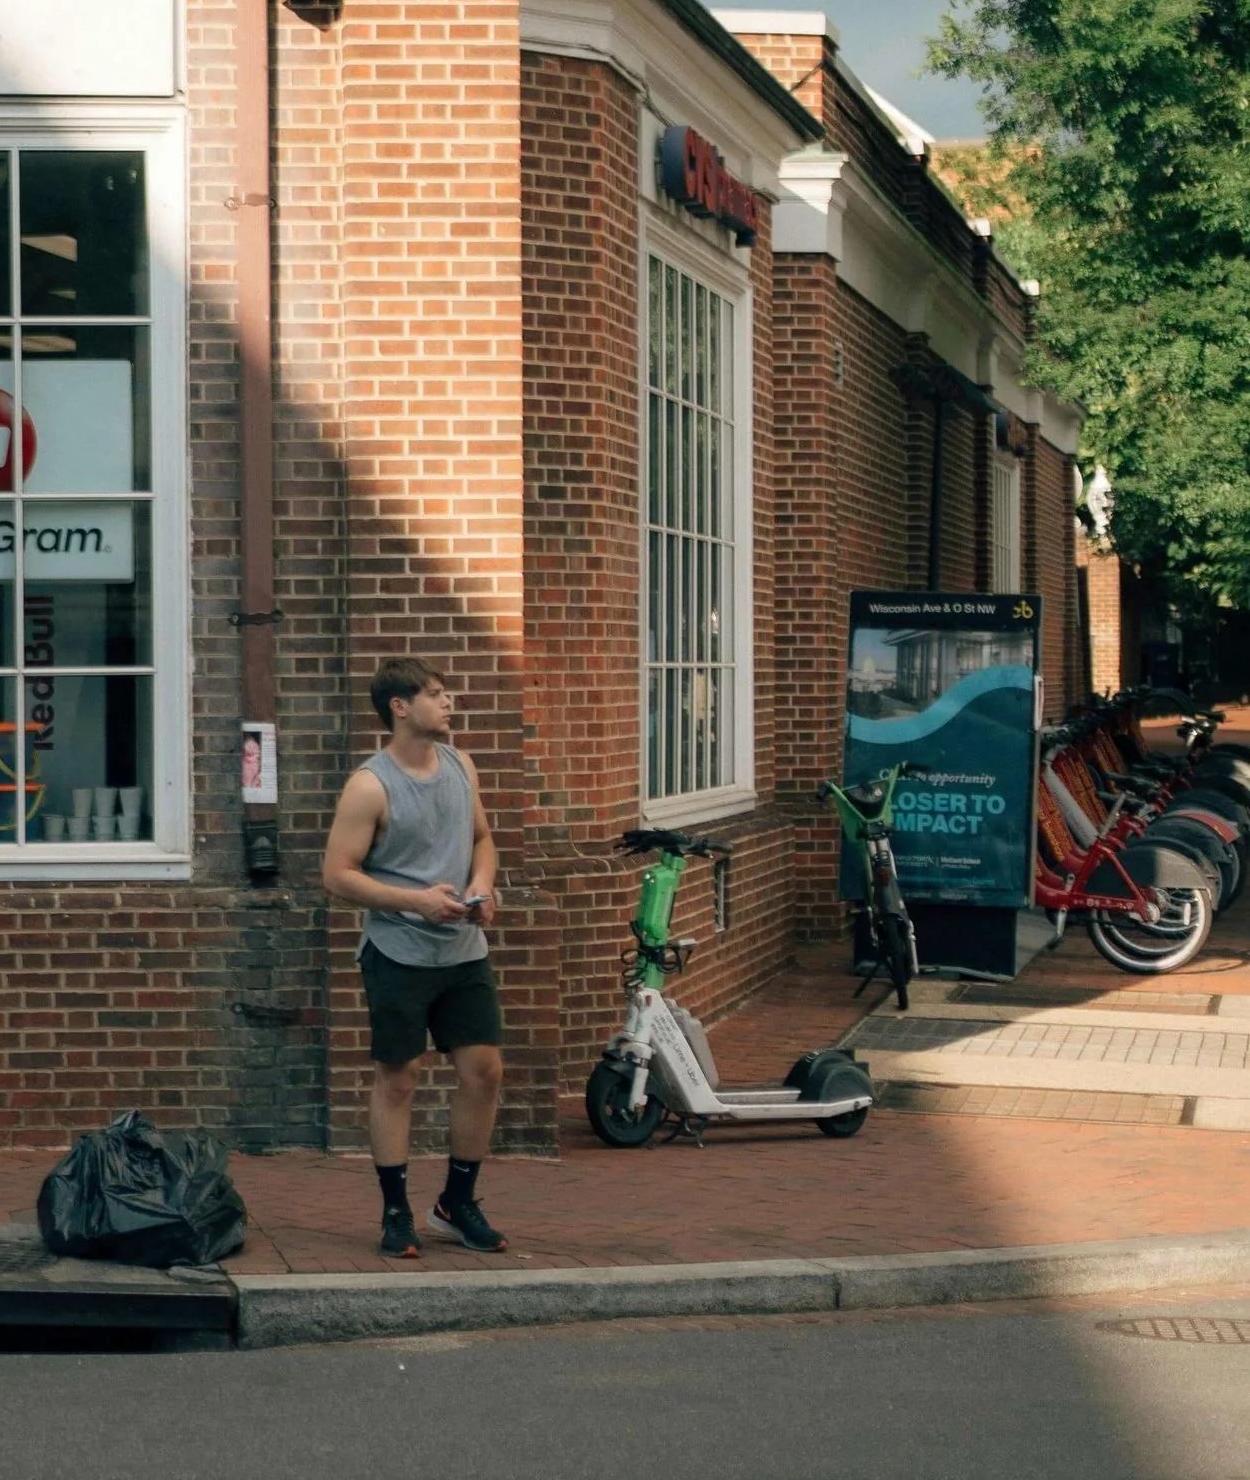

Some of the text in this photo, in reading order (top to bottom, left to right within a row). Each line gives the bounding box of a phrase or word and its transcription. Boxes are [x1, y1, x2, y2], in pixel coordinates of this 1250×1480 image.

[869, 603, 997, 615] Wisconsin Ave & O St NW
[927, 772, 997, 788] opportunity
[970, 793, 1007, 815] TO
[894, 812, 984, 835] MPACT
